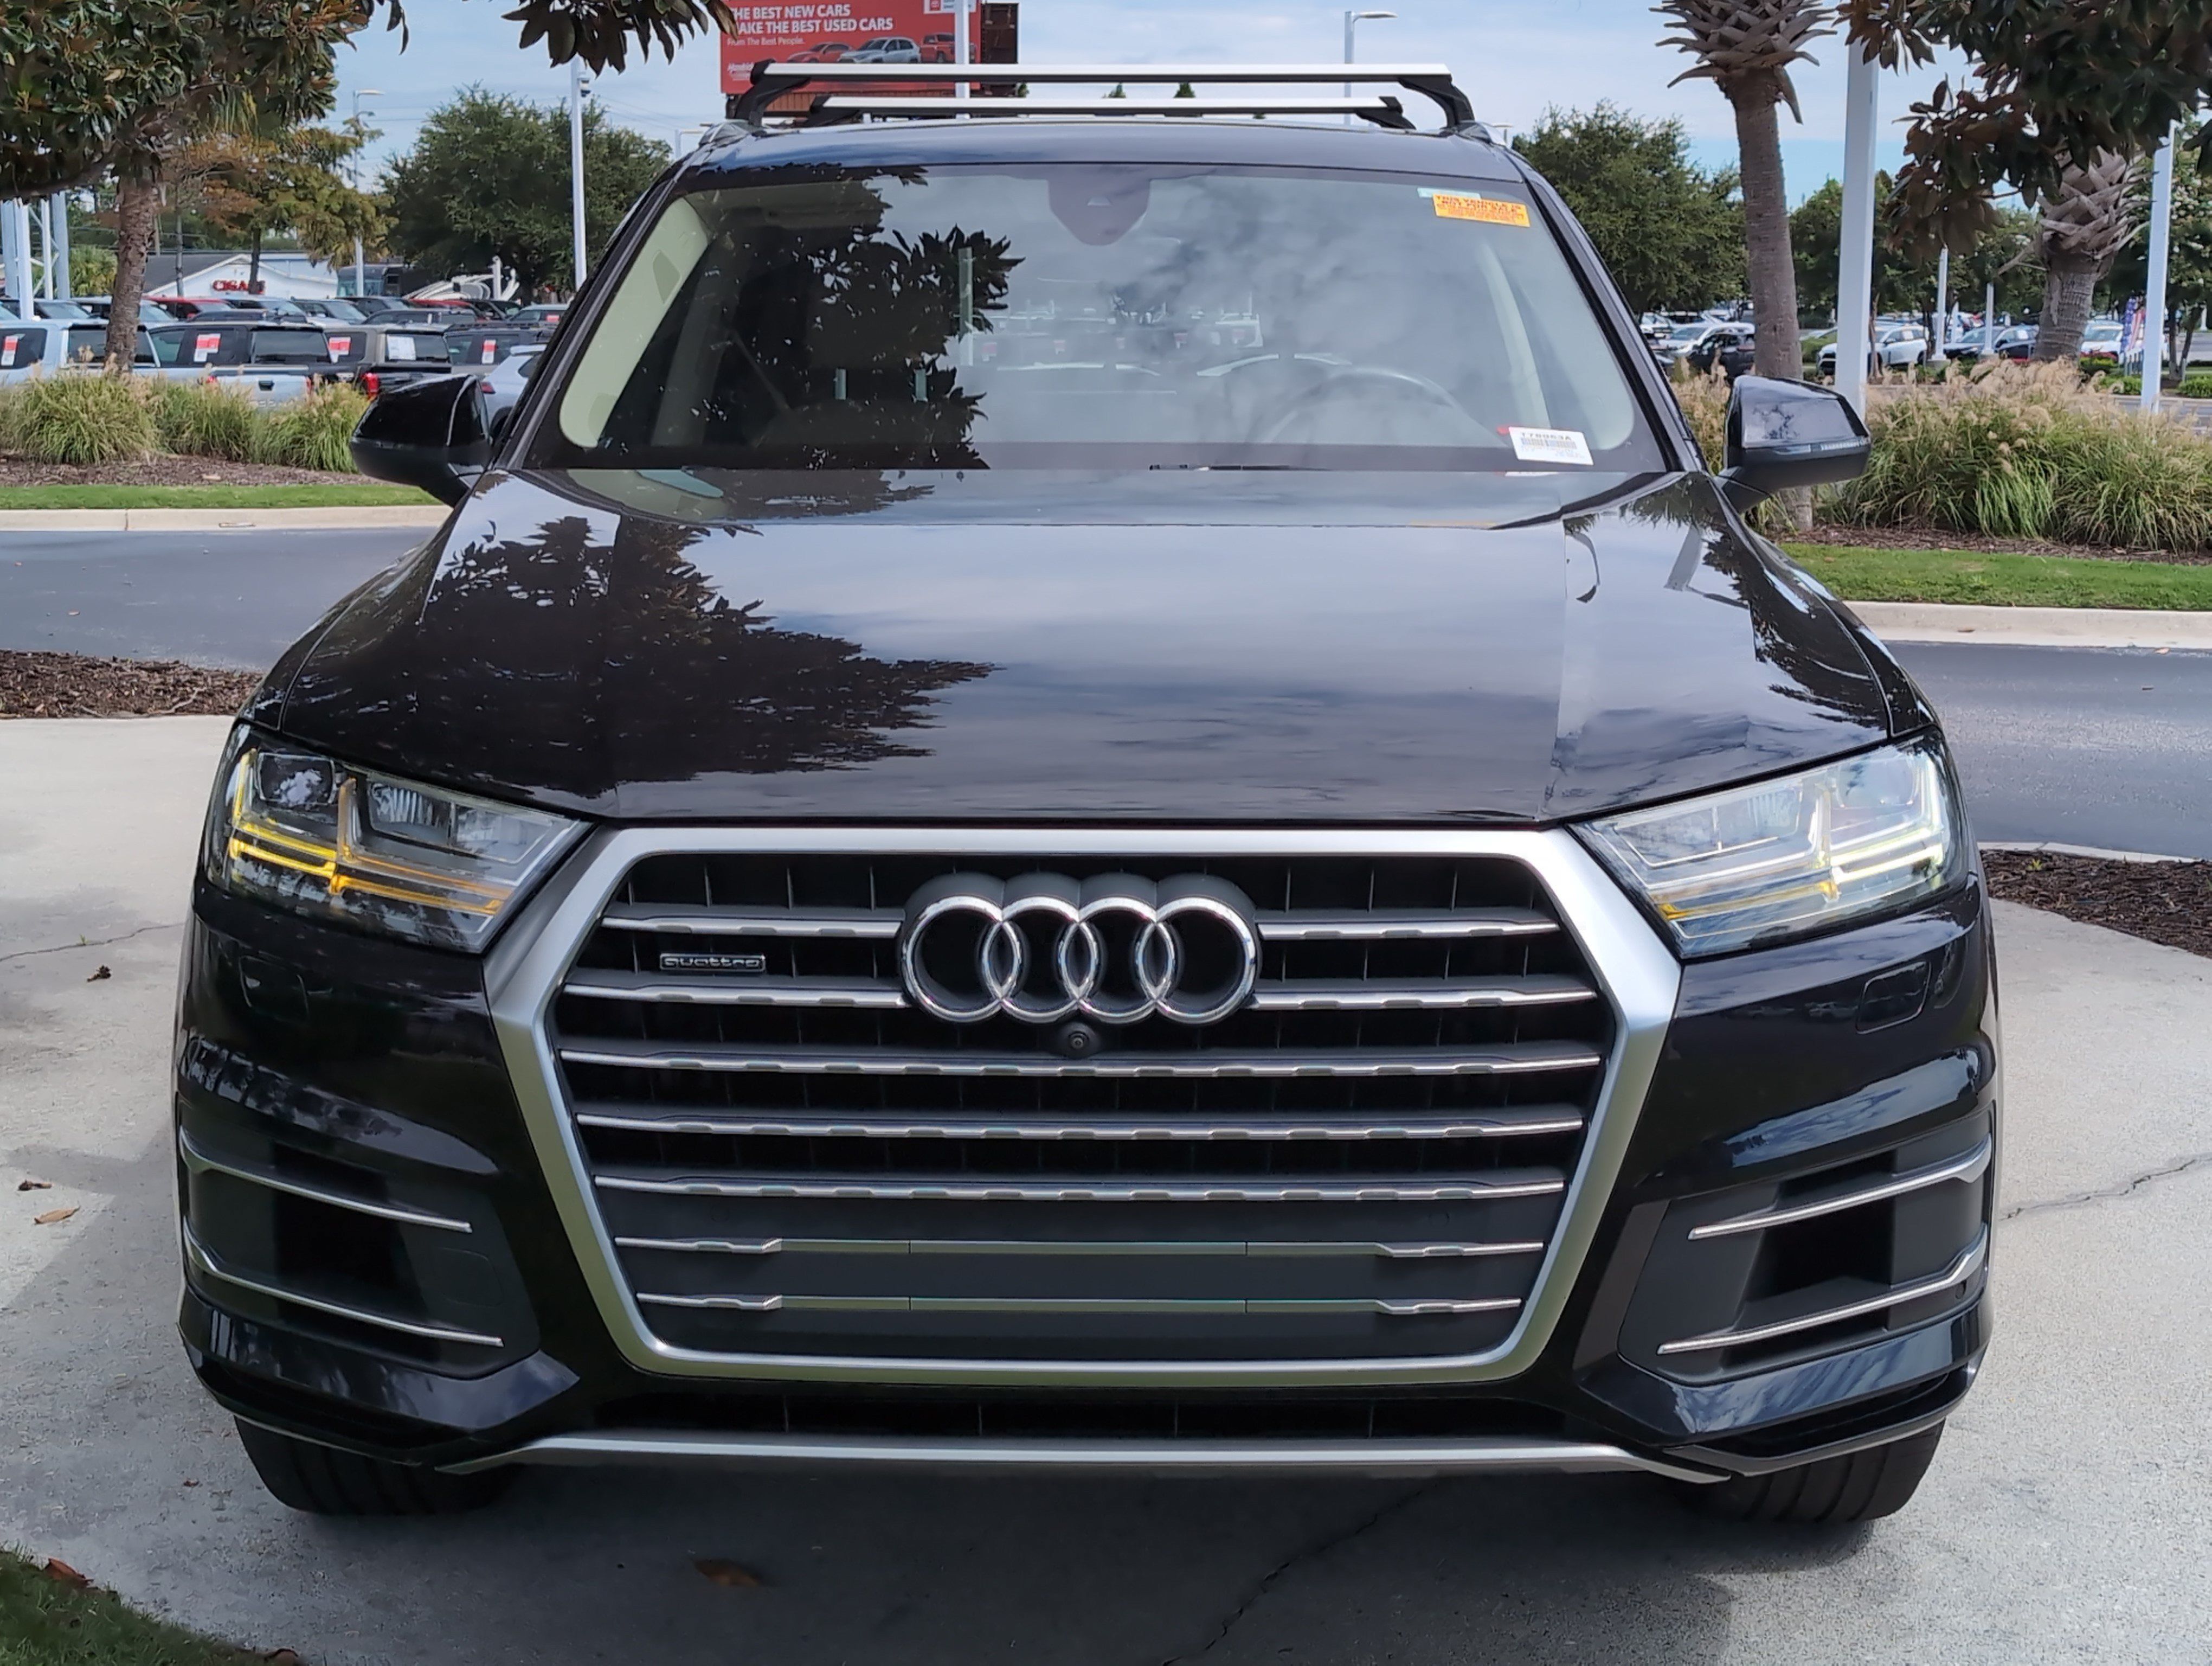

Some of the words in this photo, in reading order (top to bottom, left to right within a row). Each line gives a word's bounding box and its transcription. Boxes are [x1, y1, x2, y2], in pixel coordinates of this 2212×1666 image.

[753, 6, 782, 20] BEST
[784, 5, 815, 18] NEW
[816, 4, 851, 17] CARS
[737, 21, 763, 35] AKE
[765, 21, 789, 34] THE
[791, 20, 821, 33] BEST
[823, 18, 858, 33] USED
[859, 17, 893, 31] CARS
[664, 957, 760, 967] quattro
